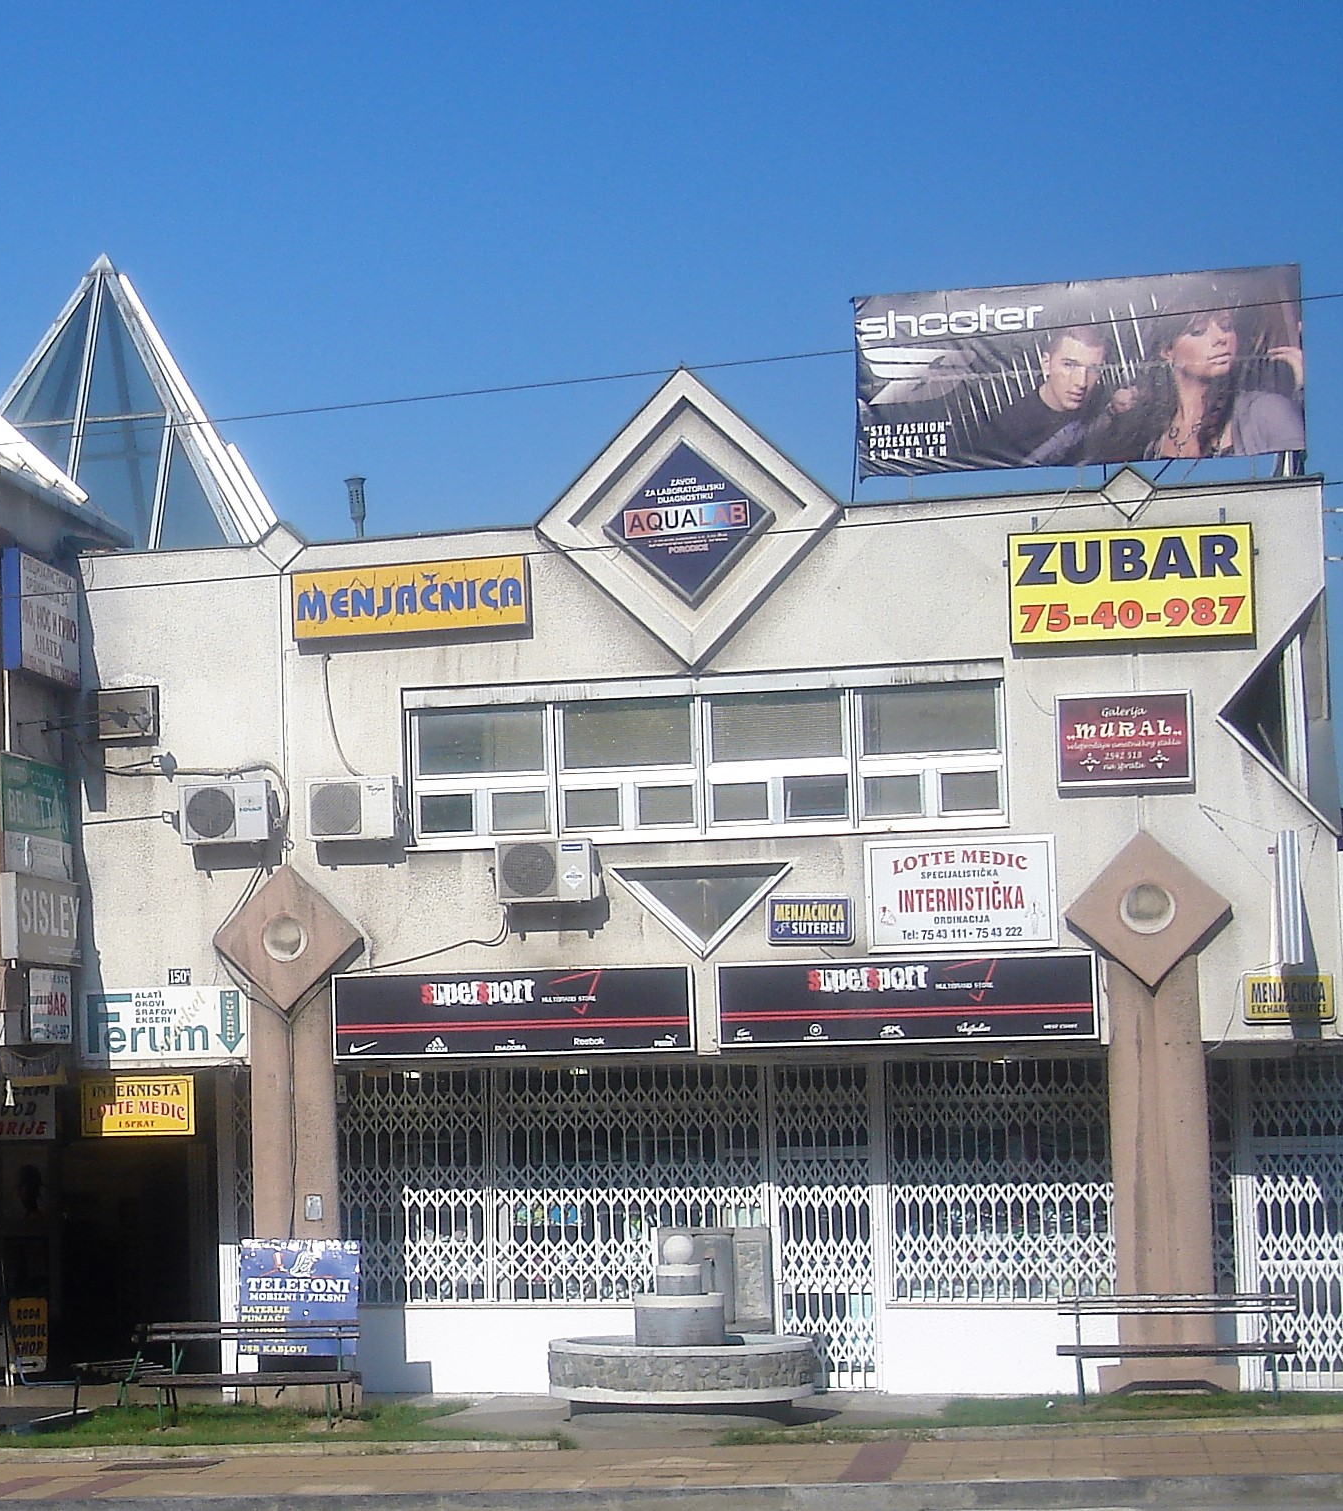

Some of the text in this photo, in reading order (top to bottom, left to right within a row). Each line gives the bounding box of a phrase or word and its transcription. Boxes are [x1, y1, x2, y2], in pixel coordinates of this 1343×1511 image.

[860, 303, 1044, 342] shooter
[925, 433, 947, 445] 158
[628, 504, 747, 533] AQUALAB
[1015, 534, 1242, 587] ZUBAR
[297, 571, 523, 624] MENJAČNICA
[1019, 595, 1247, 634] 75-40-987
[1101, 705, 1148, 718] Galerija
[892, 850, 1029, 875] LOTTE MEDIC
[920, 868, 999, 880] SPECIJALISTIČKA
[898, 881, 1026, 914] INTERNISTIČKA
[20, 887, 81, 940] SISLEY
[773, 901, 845, 922] MENJAČNICA
[933, 914, 991, 925] ORDINACIJA
[791, 921, 845, 935] SUTEREN
[902, 926, 1024, 941] Tel: 75 43 111 75 43 222
[807, 964, 930, 993] supersport
[420, 978, 536, 1008] supersport
[86, 992, 210, 1054] Ferum
[573, 1037, 606, 1046] Reebok
[92, 1083, 181, 1099] INTERNISTA
[89, 1100, 186, 1121] LOTTE MEDIC
[124, 1120, 156, 1128] SPRAT
[246, 1277, 351, 1294] TELEFONI
[248, 1293, 297, 1302] MOBILNI
[306, 1293, 347, 1303] FIKSNI
[241, 1305, 290, 1314] BATERIJE
[239, 1344, 308, 1355] USB KABLOVI
